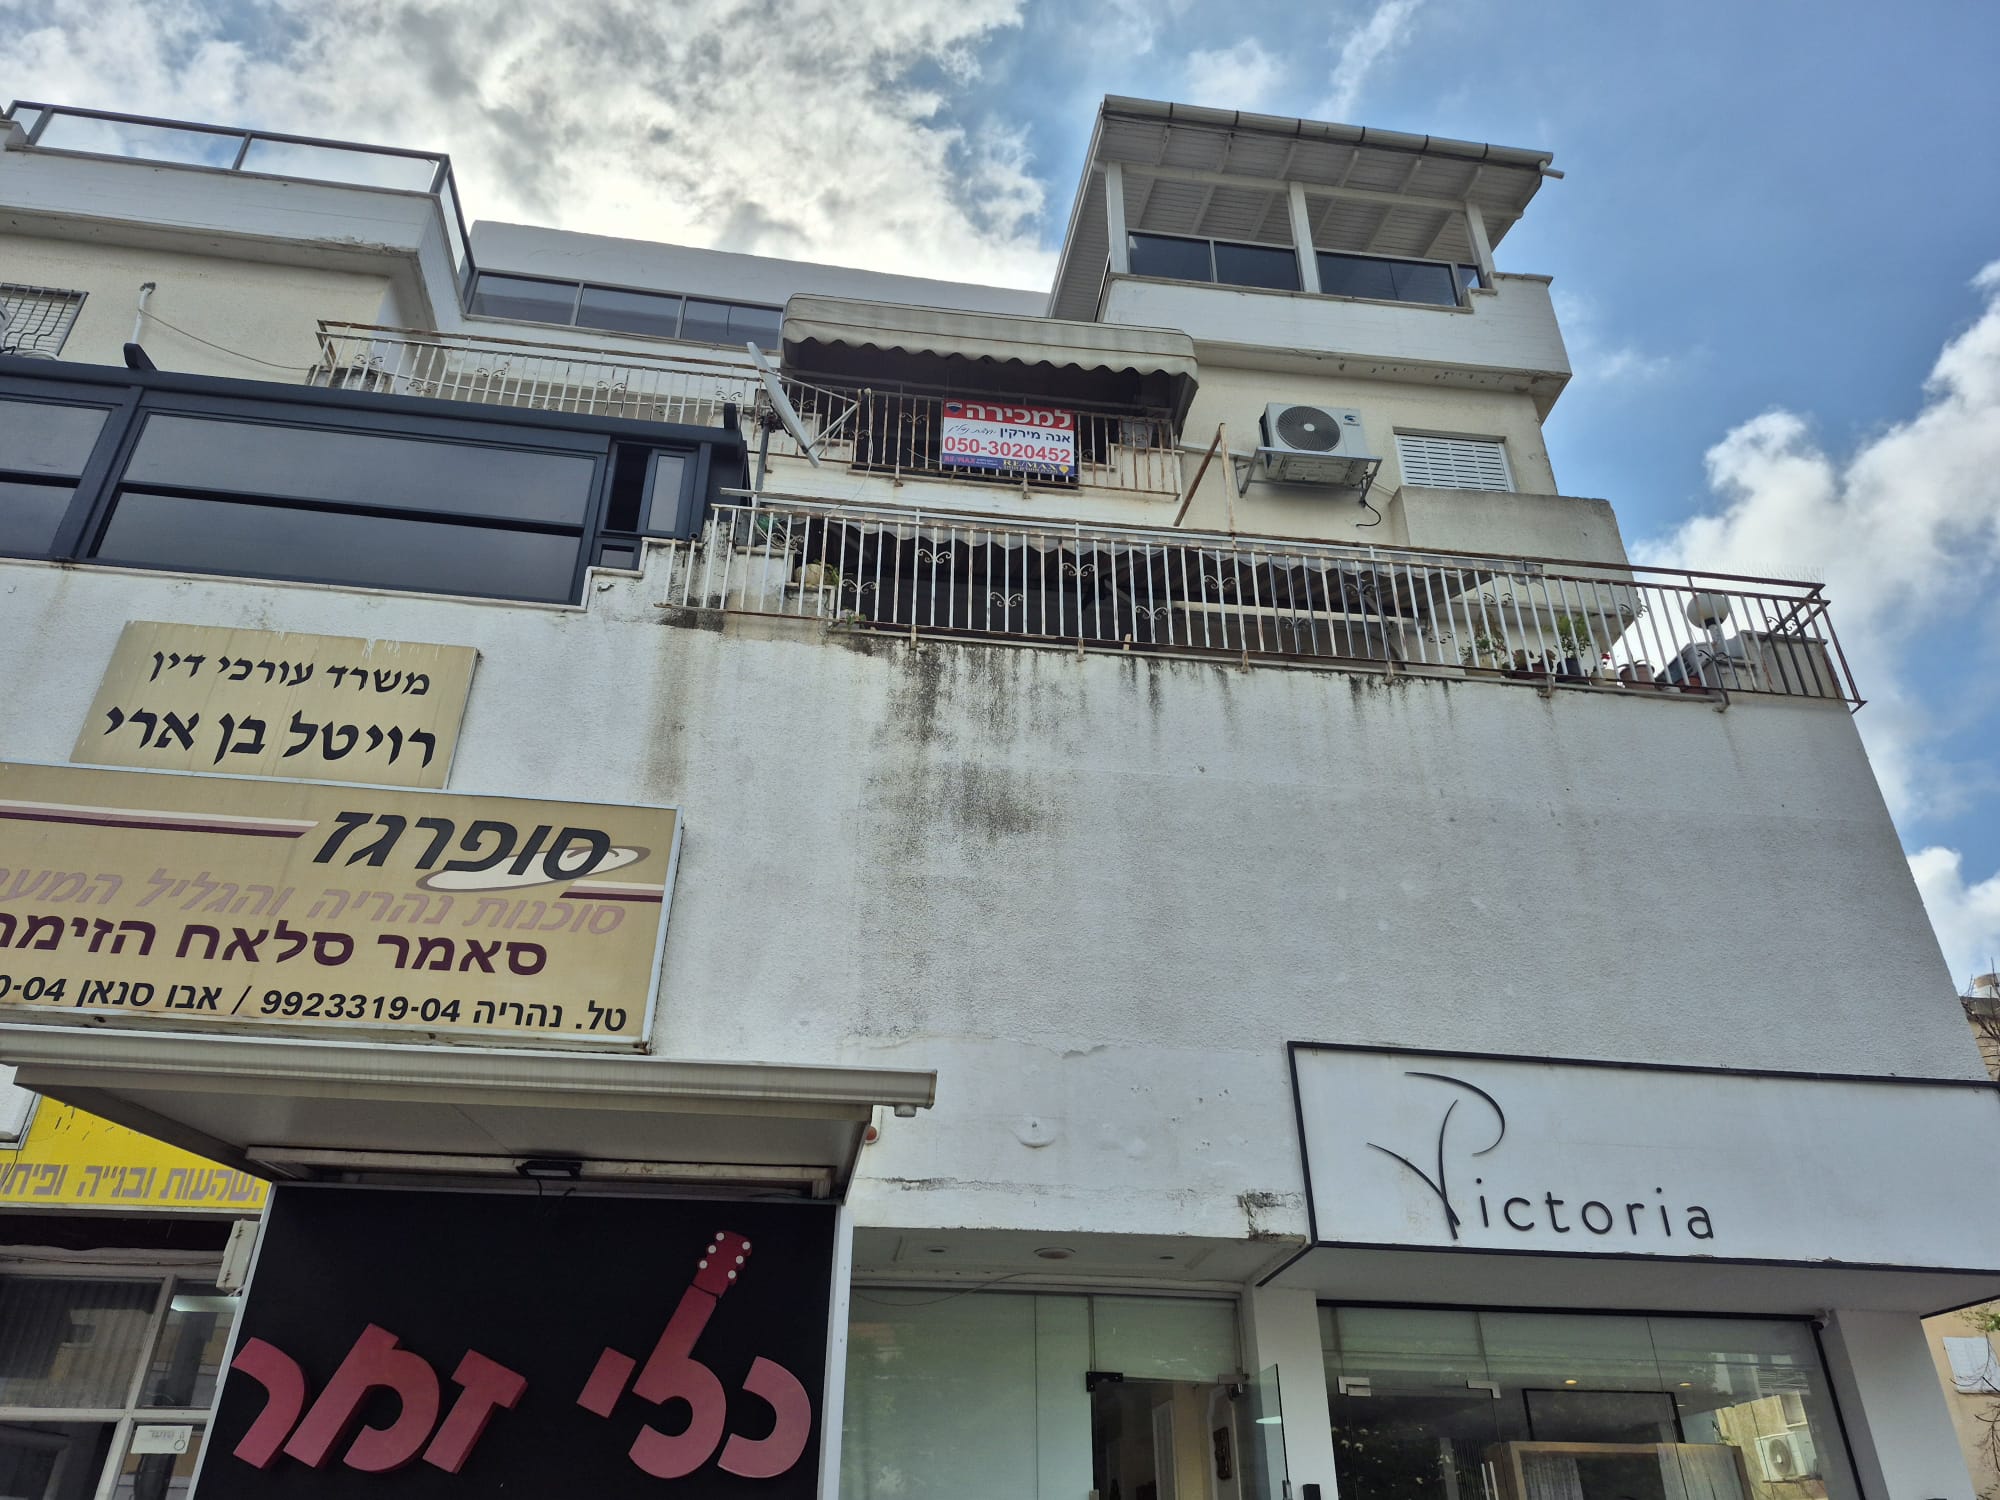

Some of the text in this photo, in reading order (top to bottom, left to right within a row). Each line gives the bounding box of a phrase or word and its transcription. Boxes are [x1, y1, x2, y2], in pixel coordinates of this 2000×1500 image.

[966, 404, 1071, 428] למכירה
[999, 427, 1041, 440] מירקין
[944, 436, 1071, 464] 050-3020452
[1045, 431, 1071, 444] אנה
[149, 651, 431, 696] משרד עורכי דין
[103, 706, 437, 769] רויטל בן ארי
[313, 810, 612, 882] סופרגז
[136, 867, 296, 919] והגליל
[306, 886, 448, 926] נהריה
[463, 896, 625, 935] סוכנות
[175, 918, 355, 966] סלאח
[376, 933, 547, 976] סאמר
[76, 980, 156, 1007] סנאן
[165, 984, 223, 1010] אבו
[259, 988, 461, 1024] 9923319-04
[473, 999, 563, 1029] נהריה
[576, 1001, 626, 1032] טל.
[1366, 1070, 1715, 1241] Victoria
[0, 1162, 69, 1197] ופיתו
[231, 1230, 812, 1479] כלי זמר
